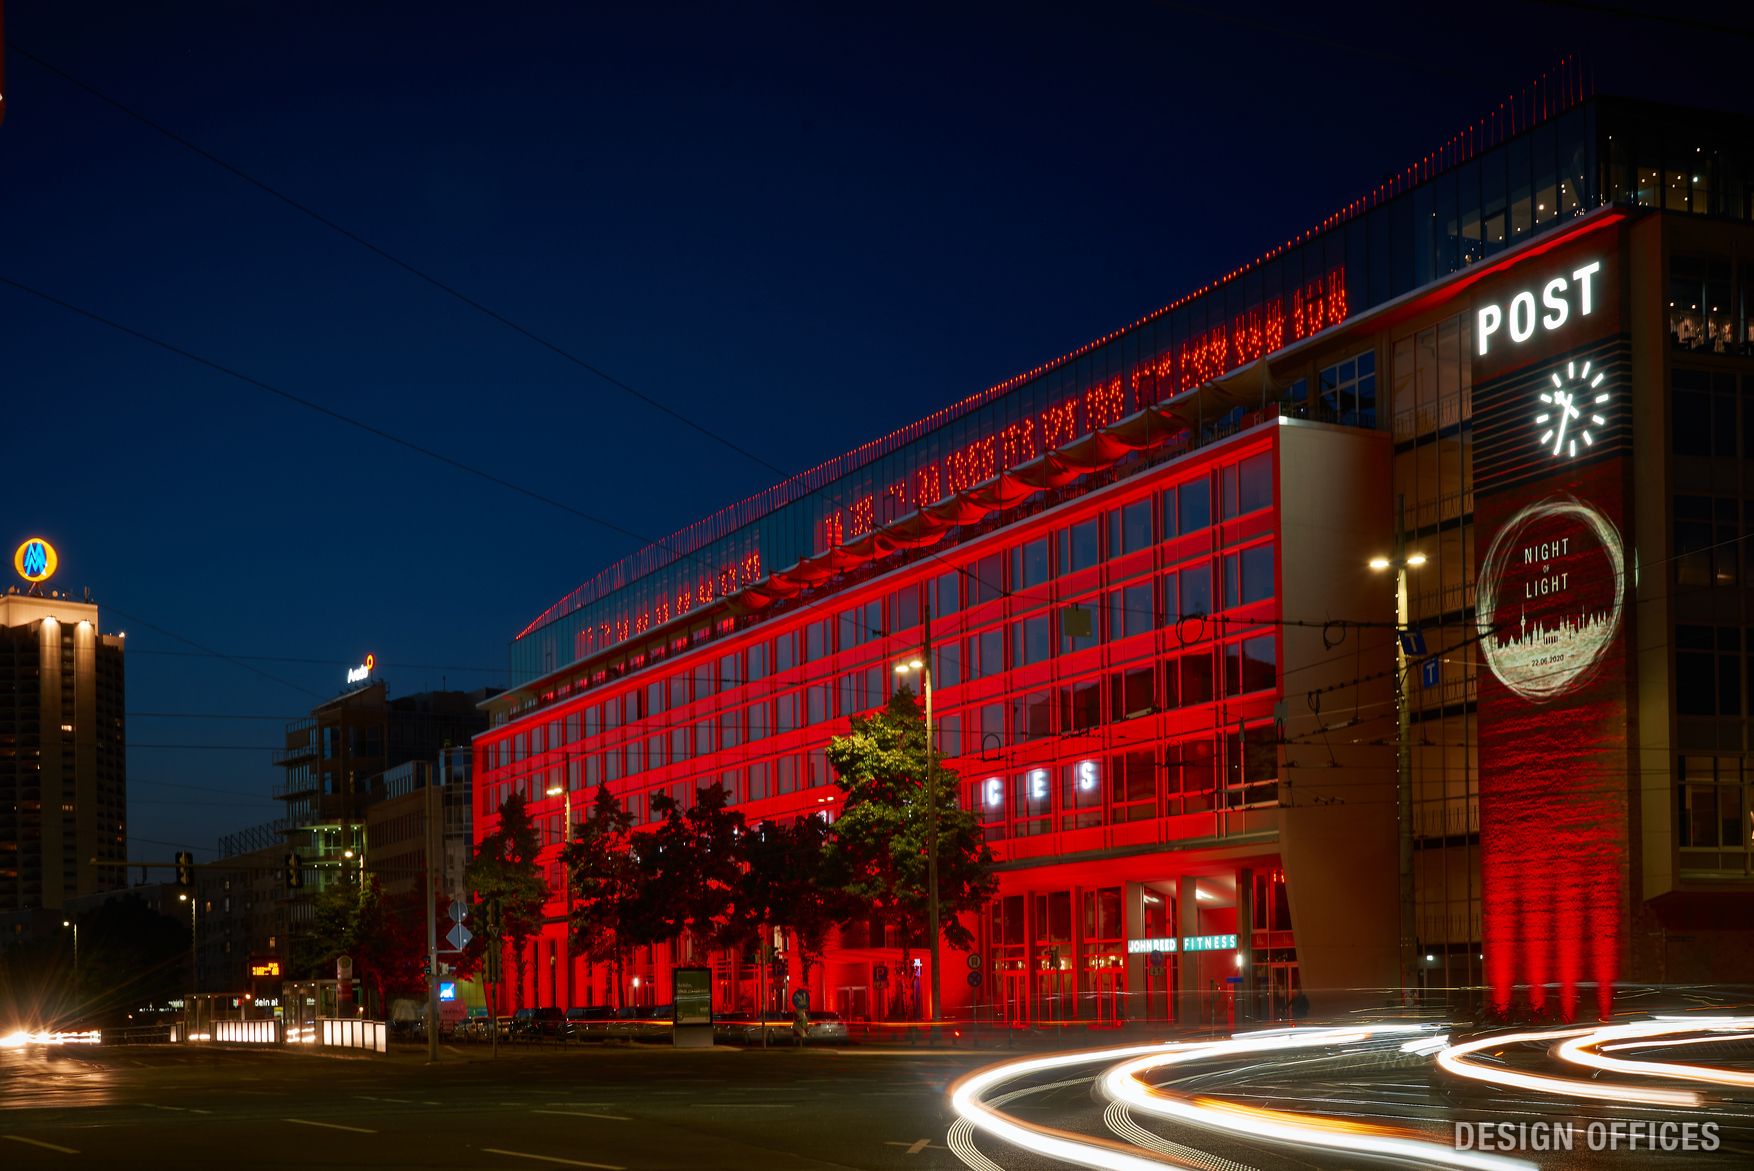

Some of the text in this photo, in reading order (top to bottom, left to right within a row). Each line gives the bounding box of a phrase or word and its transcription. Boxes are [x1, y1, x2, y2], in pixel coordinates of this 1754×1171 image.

[1478, 261, 1600, 355] POST
[1524, 537, 1569, 565] NIGHT
[1525, 572, 1568, 599] LIGHT
[1531, 654, 1565, 667] 22.06.2020
[1426, 662, 1436, 684] T
[1184, 935, 1236, 951] FITNESS
